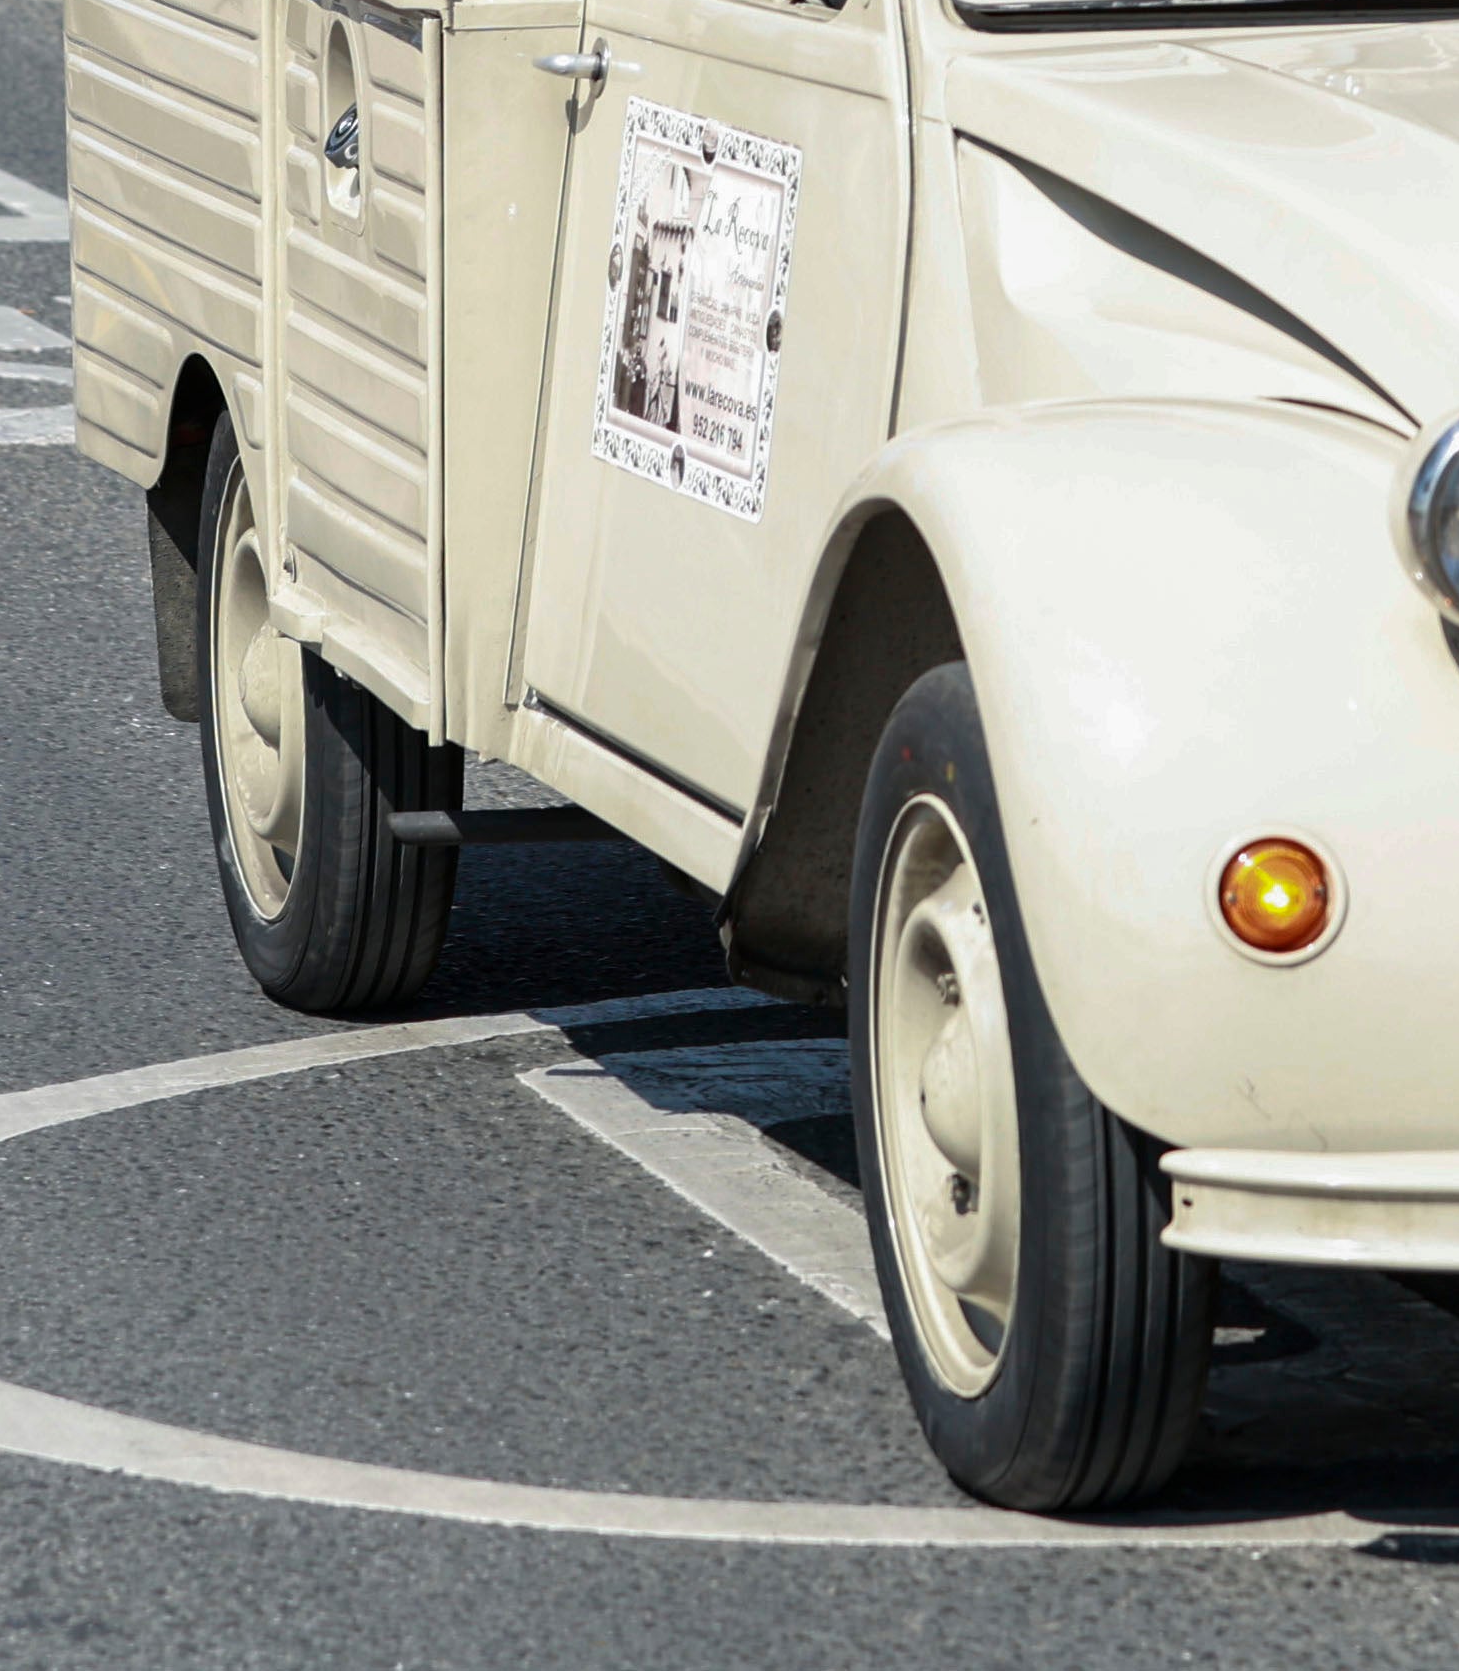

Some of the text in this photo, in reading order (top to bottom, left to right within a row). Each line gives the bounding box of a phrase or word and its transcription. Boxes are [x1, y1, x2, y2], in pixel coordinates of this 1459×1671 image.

[703, 190, 722, 235] La
[685, 380, 757, 422] www.larecova.es
[693, 413, 744, 452] 952 216 794
